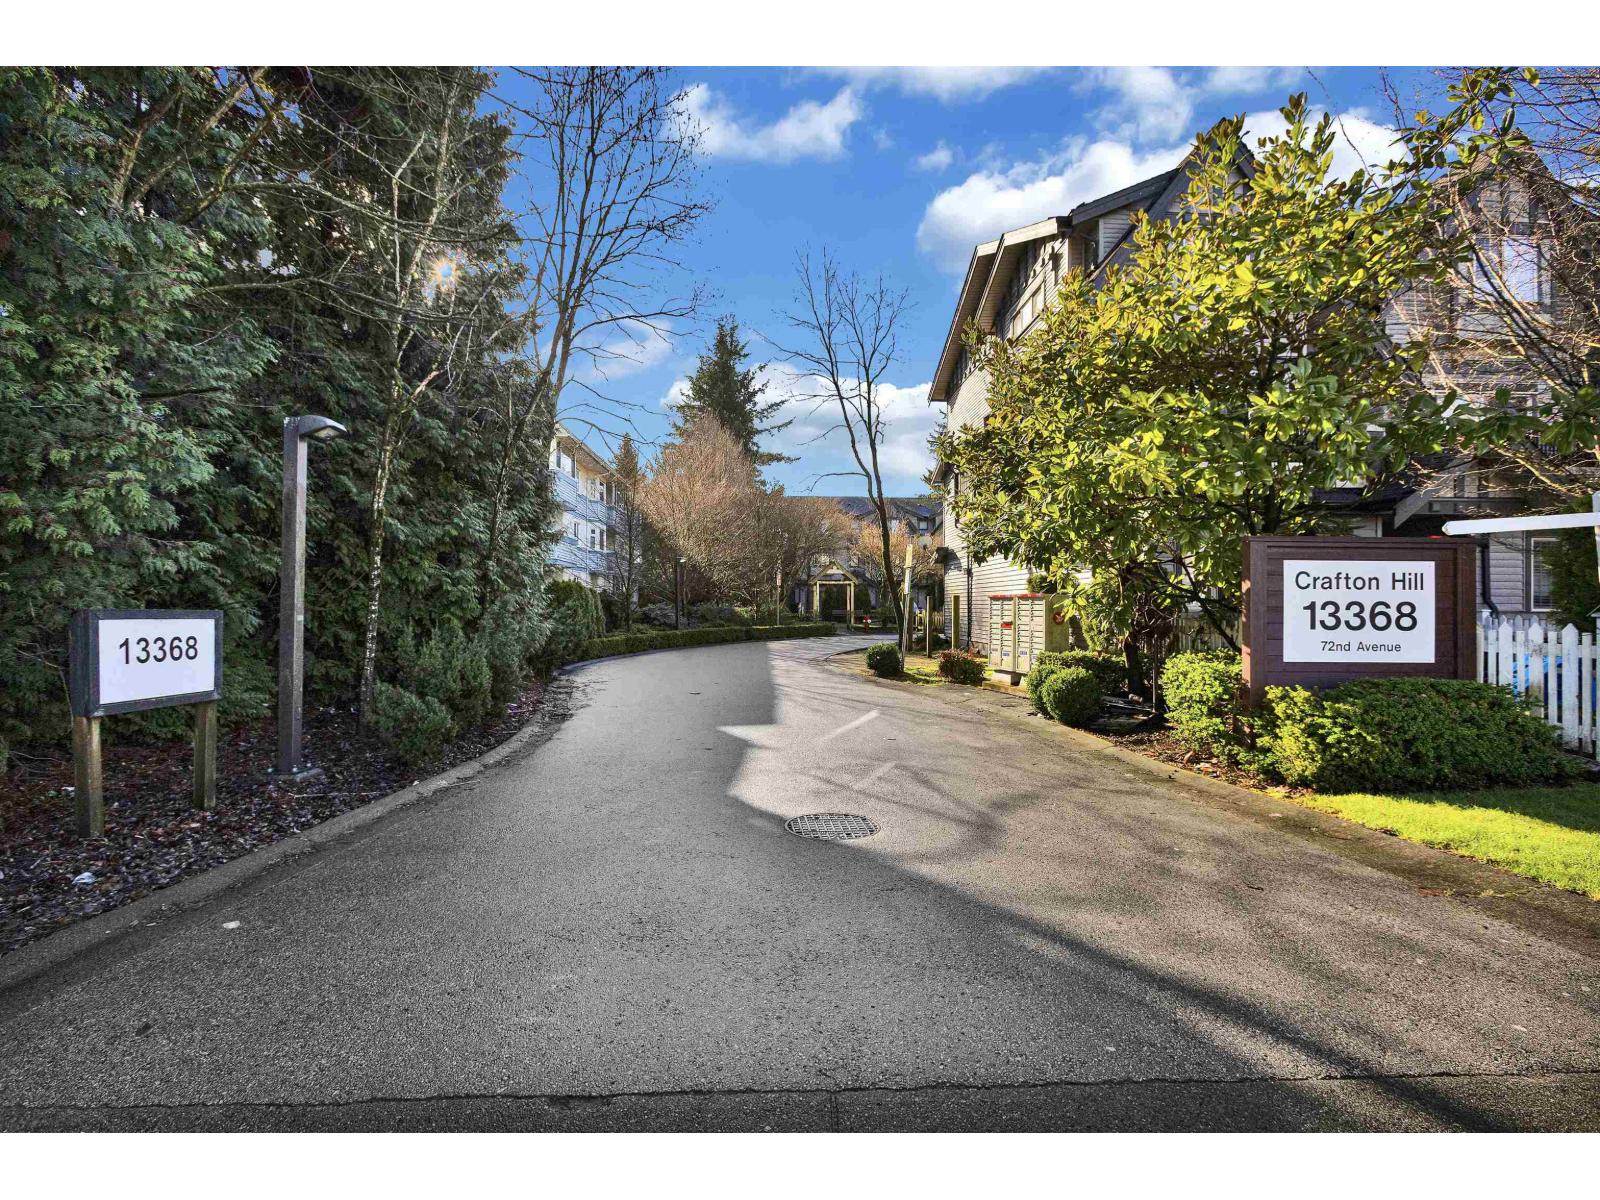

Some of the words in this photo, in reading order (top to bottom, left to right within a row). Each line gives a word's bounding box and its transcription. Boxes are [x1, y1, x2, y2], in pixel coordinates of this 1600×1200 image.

[1294, 571, 1380, 591] Crafton
[1391, 572, 1424, 591] Hill
[1302, 600, 1418, 632] 13368
[119, 635, 198, 665] 13368
[1320, 640, 1351, 652] 72nd
[1356, 641, 1402, 653] Avenue
